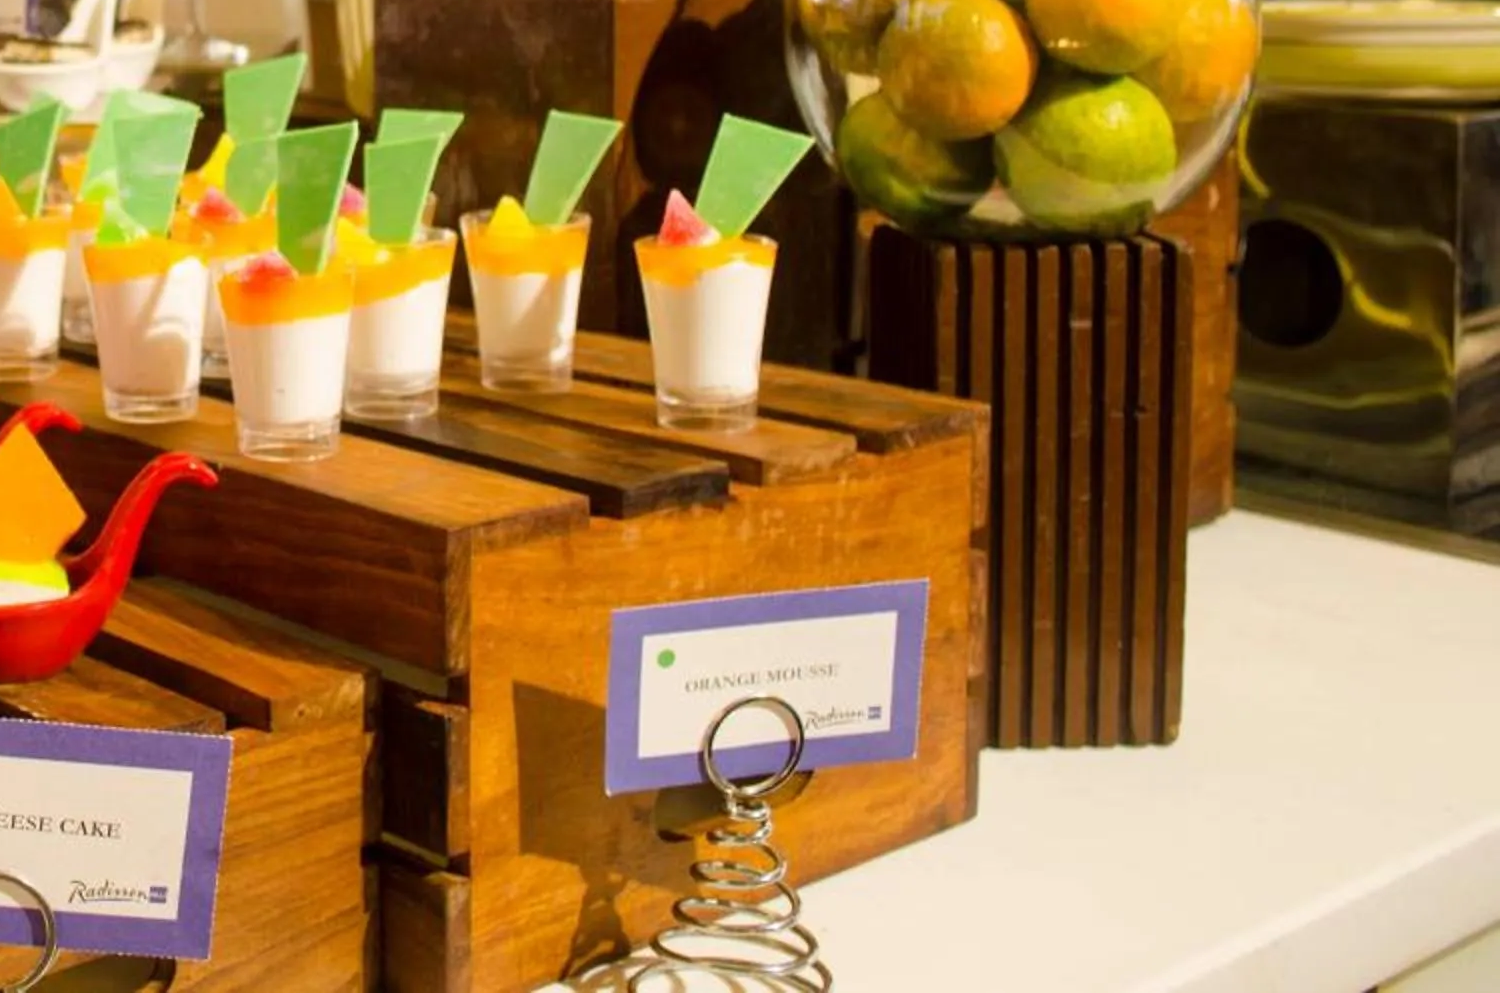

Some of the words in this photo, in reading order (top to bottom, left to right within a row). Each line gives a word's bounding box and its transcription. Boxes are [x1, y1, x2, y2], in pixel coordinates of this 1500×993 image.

[684, 671, 760, 693] ORANGE
[766, 662, 841, 684] MOUSSE
[59, 818, 122, 839] CAKE
